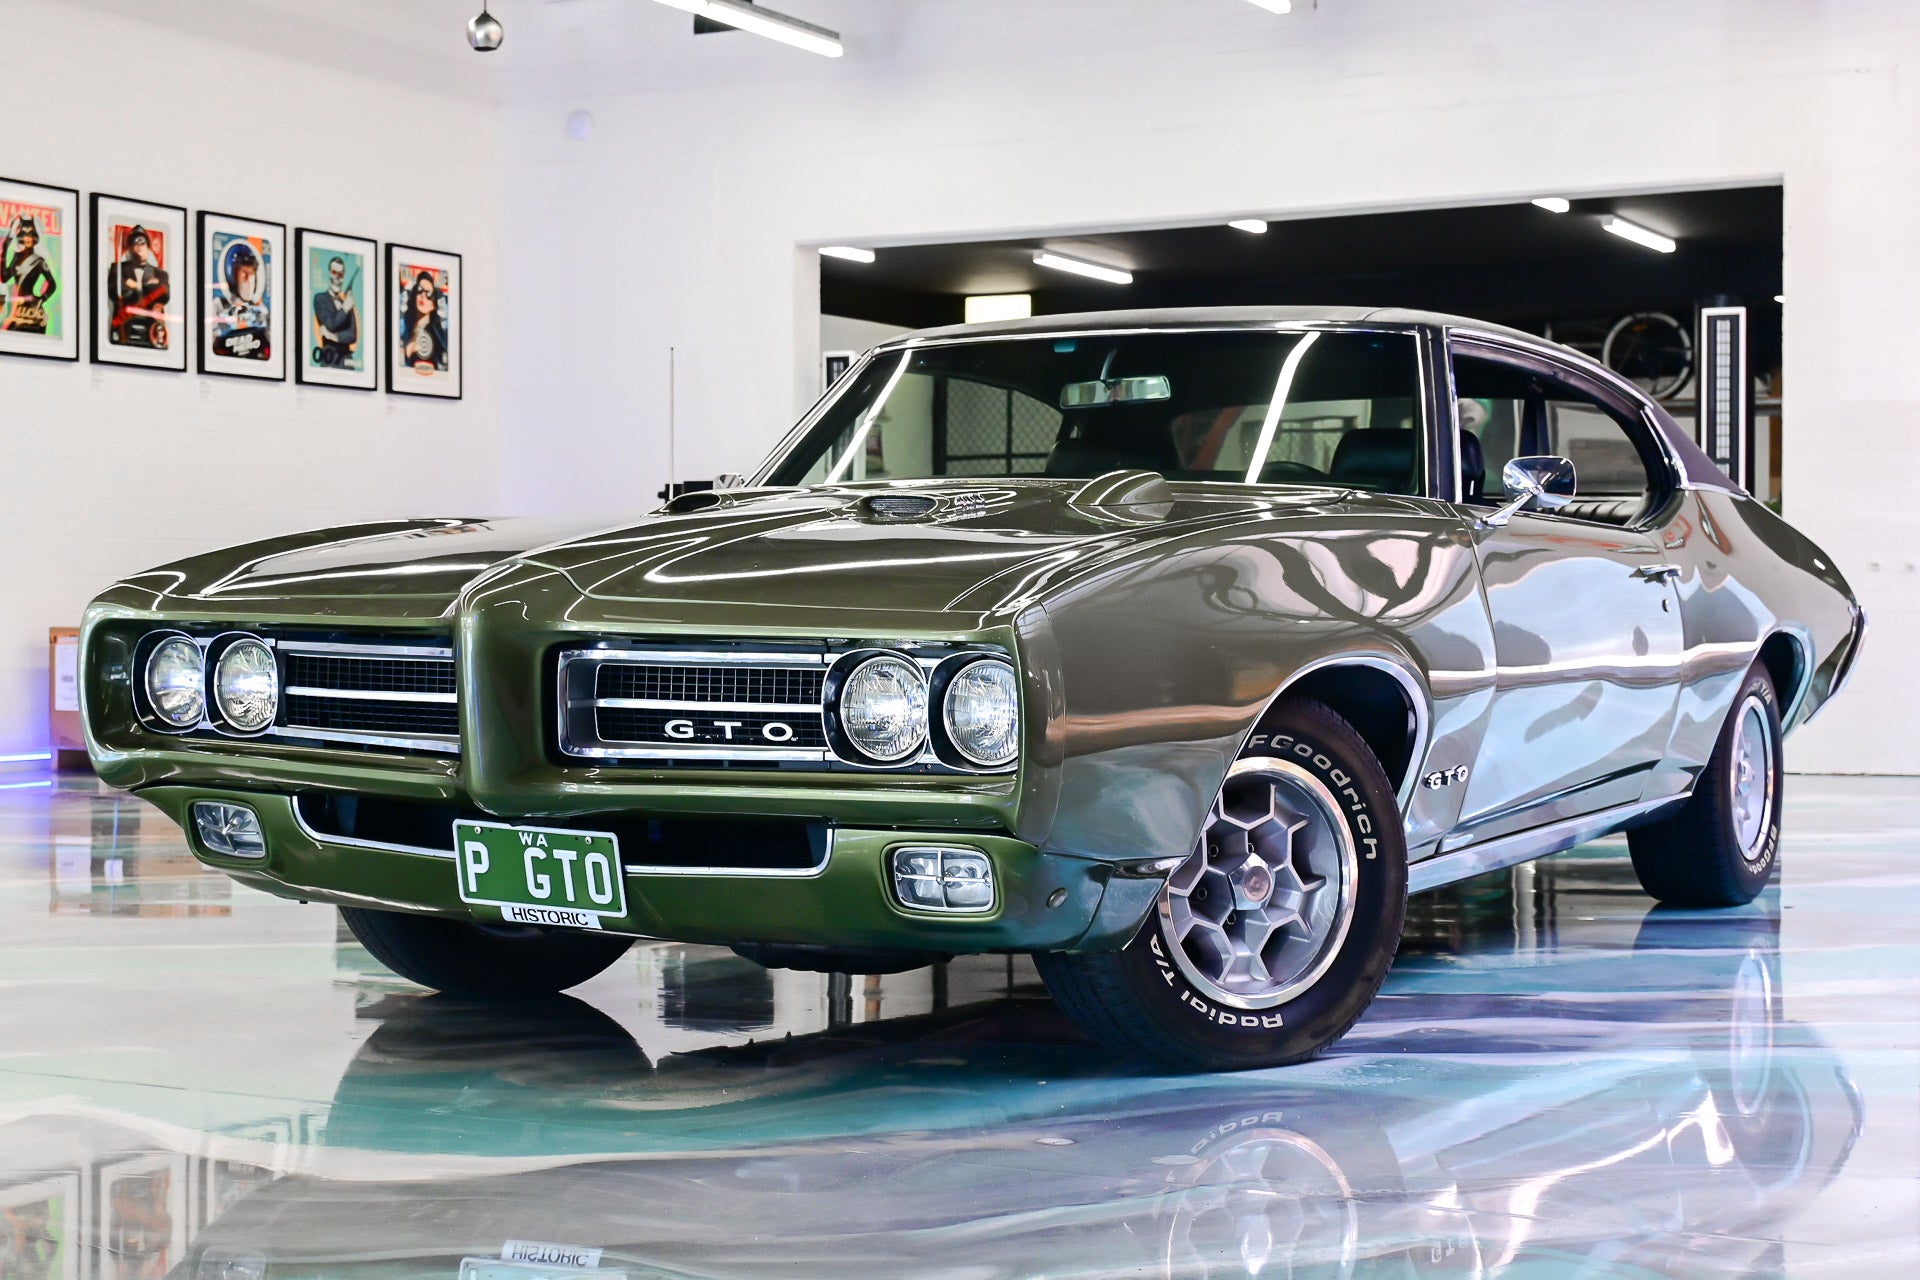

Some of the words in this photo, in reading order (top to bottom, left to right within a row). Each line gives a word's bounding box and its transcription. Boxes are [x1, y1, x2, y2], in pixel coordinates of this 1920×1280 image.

[1248, 734, 1378, 860] FGoodrich
[1424, 764, 1469, 790] GTO
[518, 831, 549, 848] WA
[464, 840, 490, 893] P
[523, 847, 613, 905] GTO
[511, 907, 589, 926] HISTORIC
[1150, 933, 1175, 987] T/A
[1180, 989, 1284, 1029] Radial
